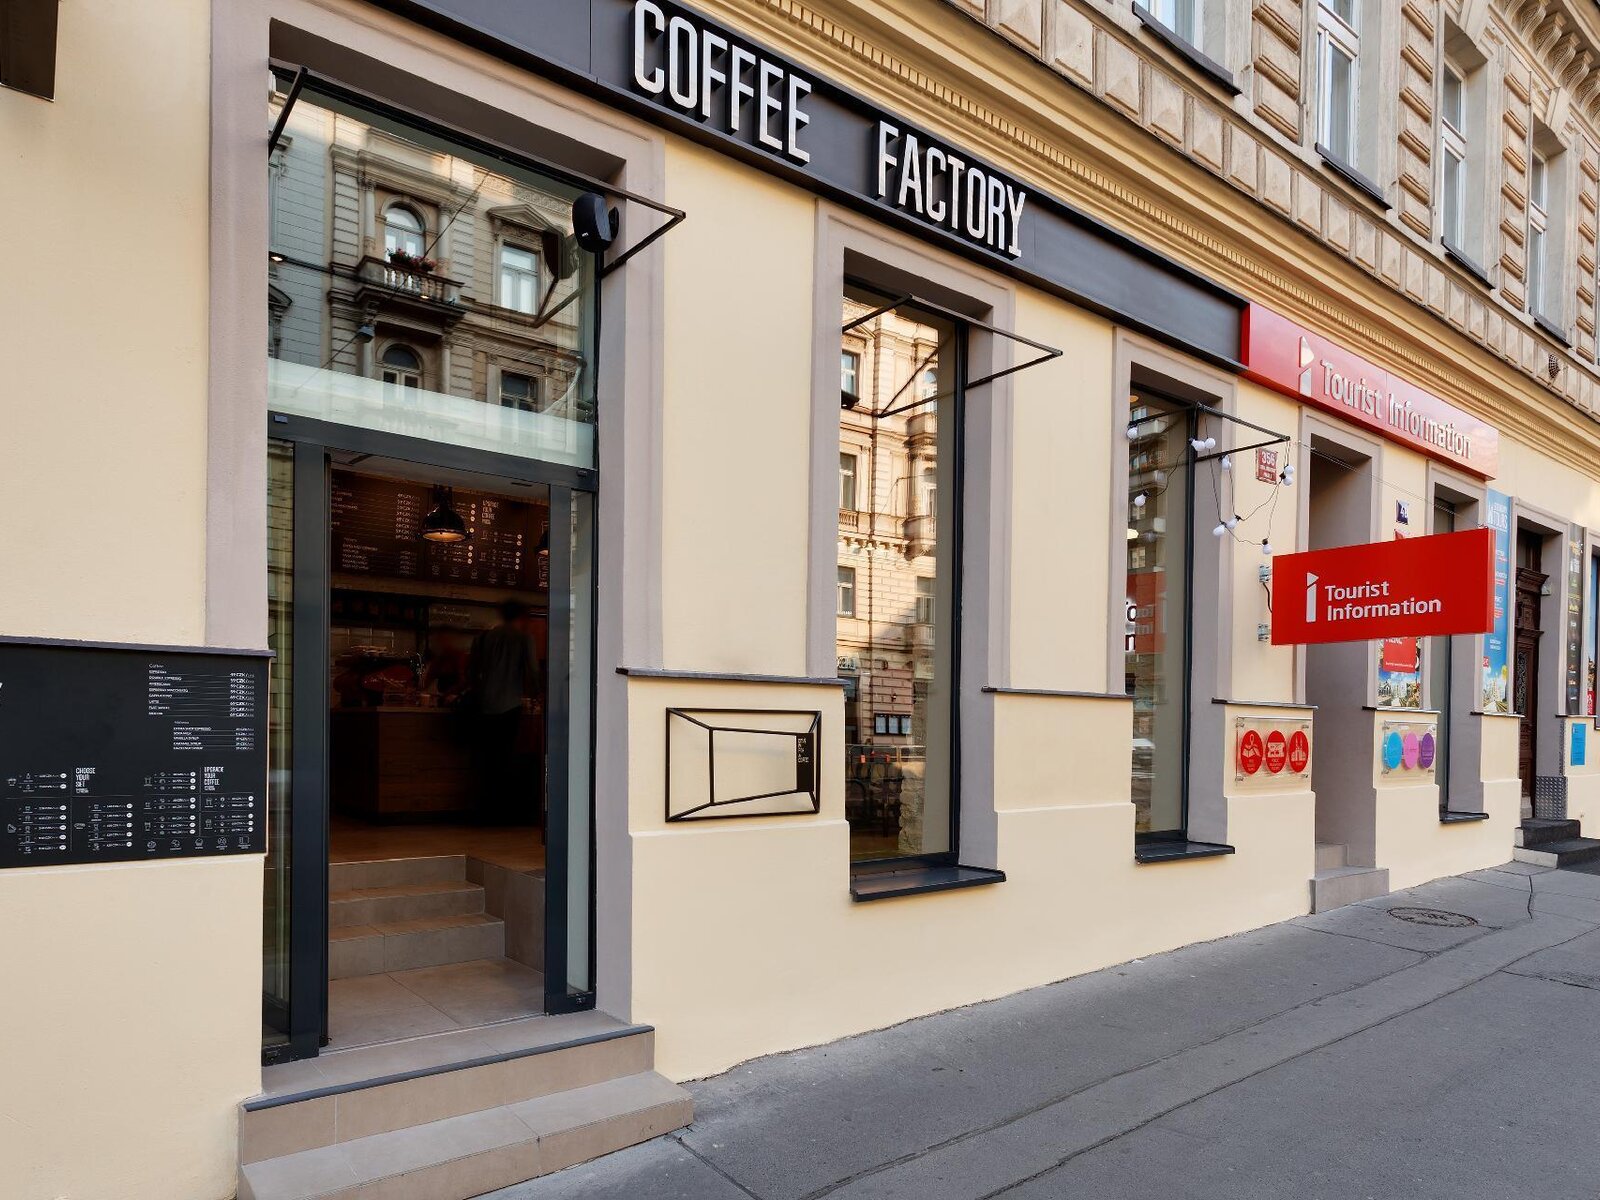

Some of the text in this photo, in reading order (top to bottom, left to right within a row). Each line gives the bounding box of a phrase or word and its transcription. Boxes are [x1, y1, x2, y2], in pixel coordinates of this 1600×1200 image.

[634, 0, 1027, 257] COFFEE FACTORY
[1320, 359, 1383, 420] Tourist
[1388, 392, 1473, 460] Information
[1324, 580, 1390, 601] Tourist
[1327, 597, 1442, 621] Information
